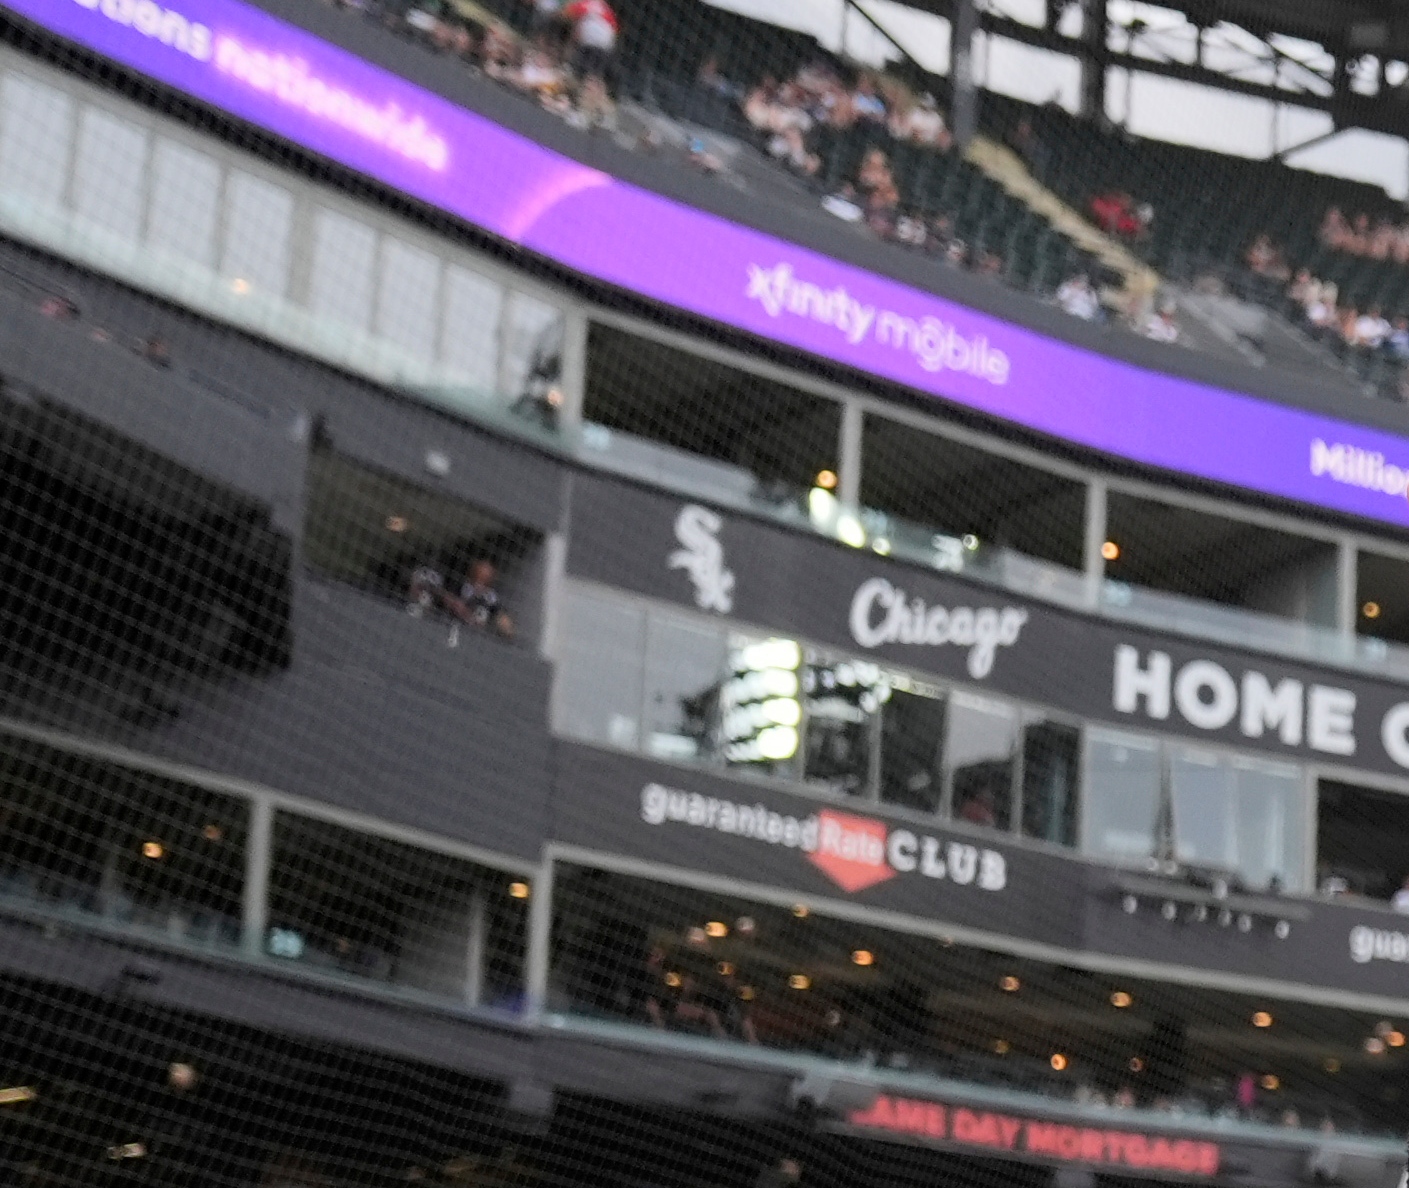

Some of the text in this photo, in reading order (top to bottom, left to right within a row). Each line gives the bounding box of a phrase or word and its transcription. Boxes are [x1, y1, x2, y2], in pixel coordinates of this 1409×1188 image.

[72, 0, 212, 62] tions
[746, 262, 1010, 385] xfinity mobile
[848, 577, 1029, 680] Chicago
[1113, 645, 1356, 756] HOME
[641, 782, 1007, 891] guaranteed Rate CLUB
[953, 1107, 1020, 1151] DAY
[1026, 1119, 1219, 1176] MORTGAGE
